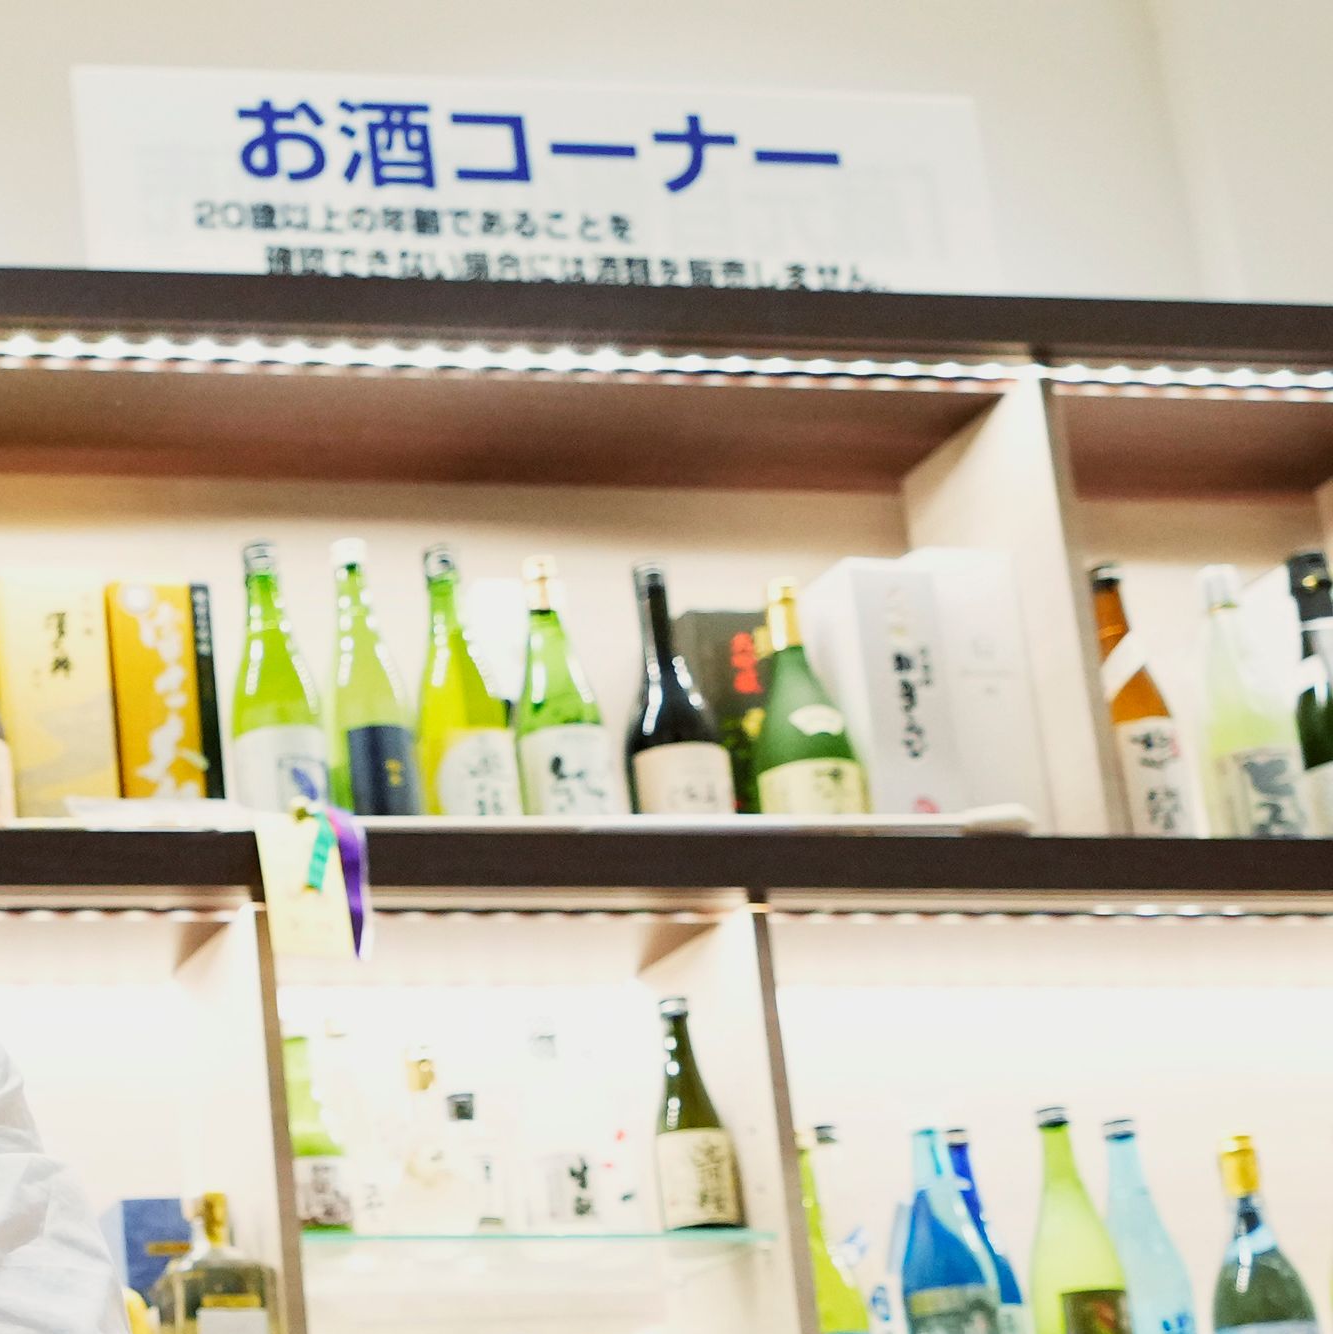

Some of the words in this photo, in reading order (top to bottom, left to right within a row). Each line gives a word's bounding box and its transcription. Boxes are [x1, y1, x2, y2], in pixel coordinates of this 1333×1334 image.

[237, 99, 840, 195] お酒コーナー
